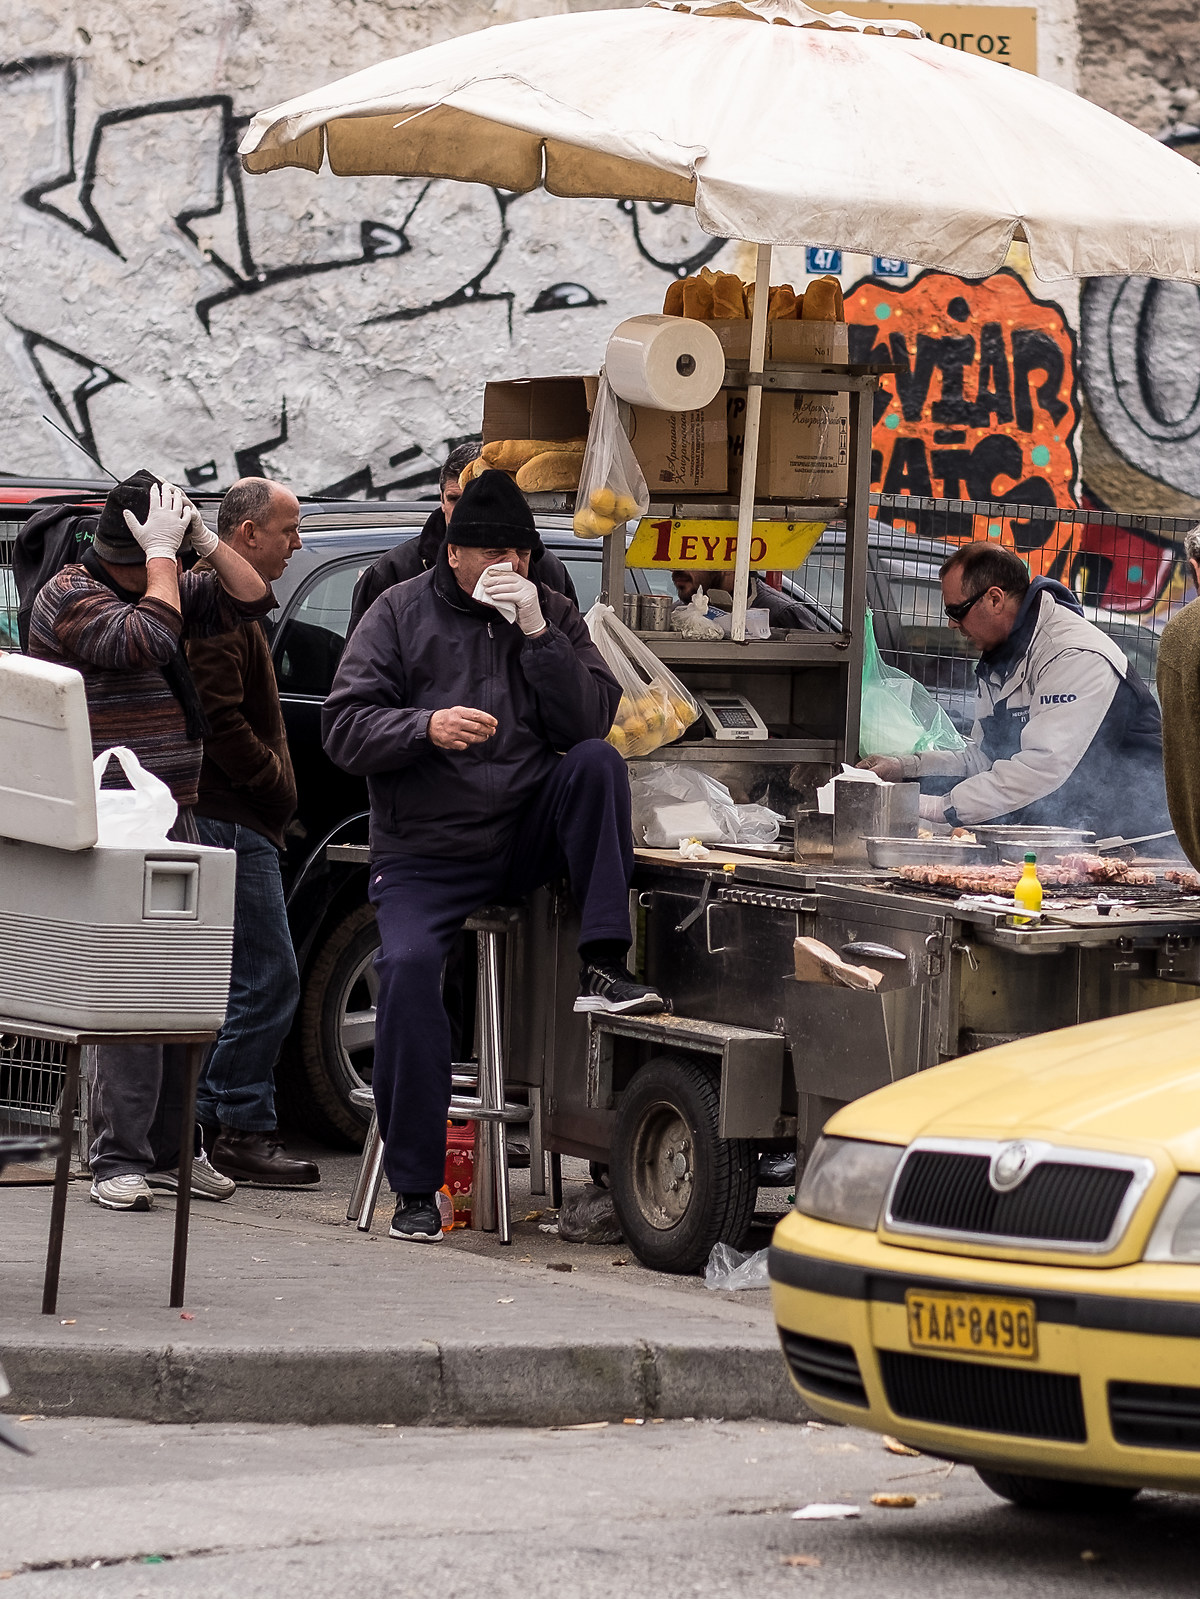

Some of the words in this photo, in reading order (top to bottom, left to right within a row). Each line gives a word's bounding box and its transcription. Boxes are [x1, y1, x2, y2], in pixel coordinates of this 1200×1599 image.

[814, 247, 836, 269] 47
[650, 520, 673, 562] 1
[1040, 694, 1077, 705] IVECO
